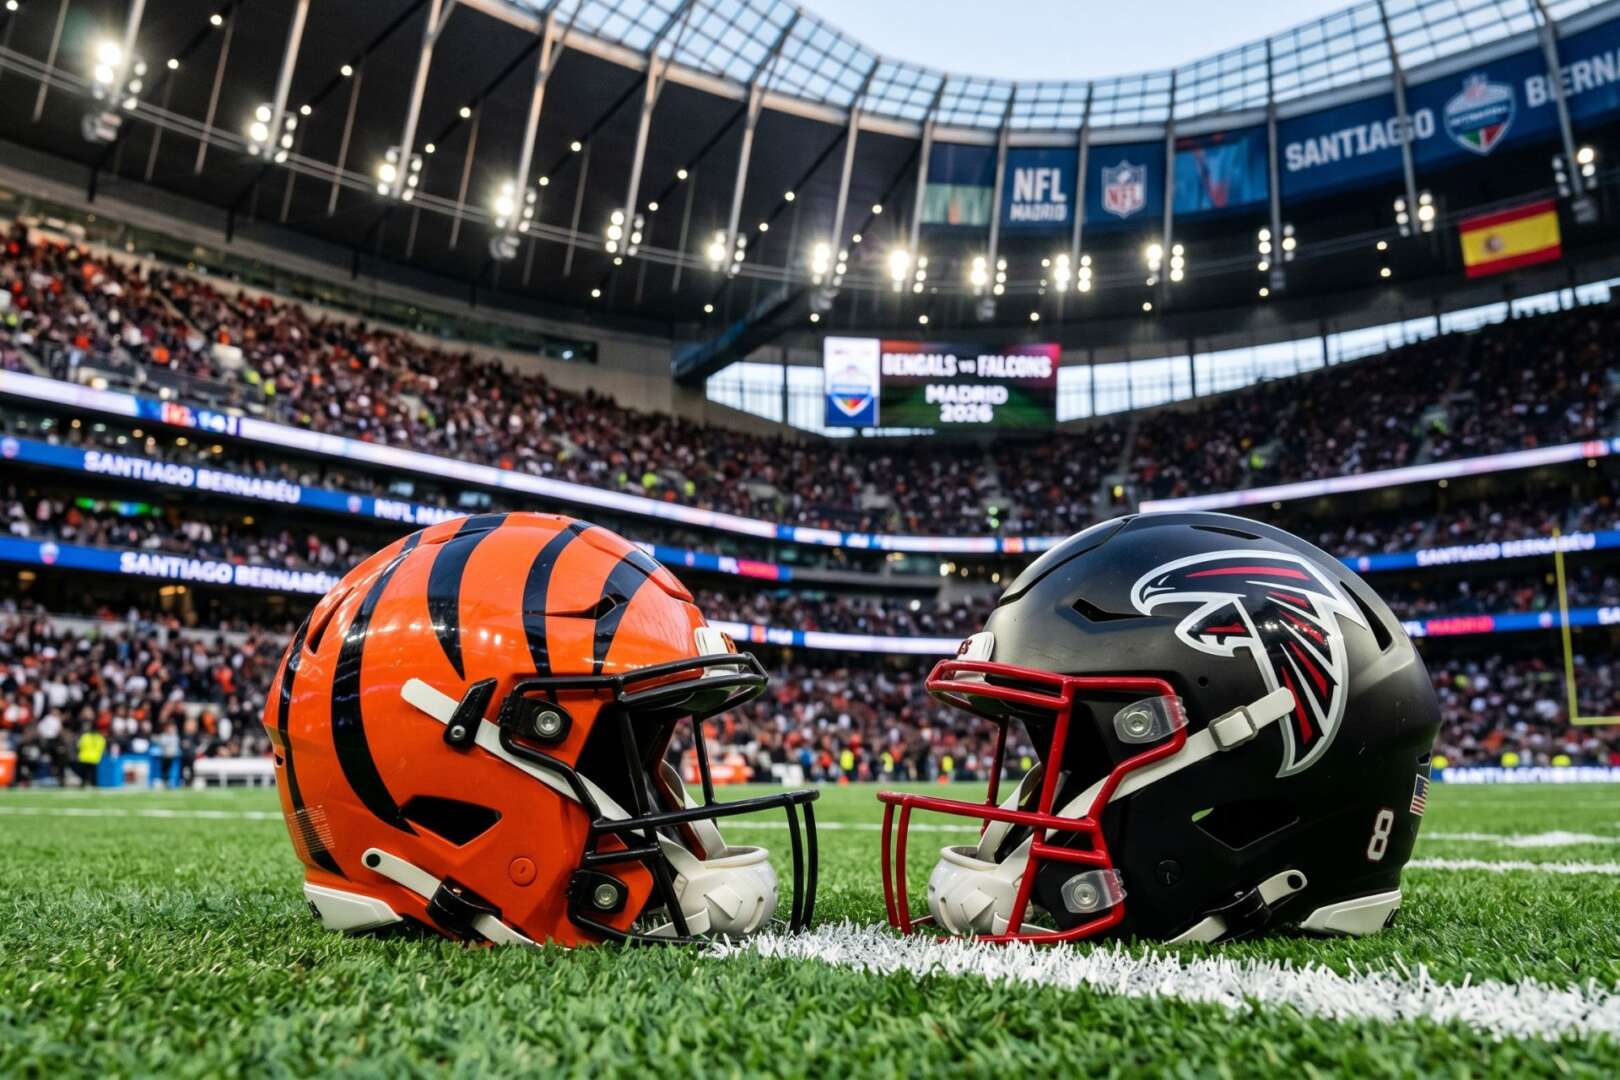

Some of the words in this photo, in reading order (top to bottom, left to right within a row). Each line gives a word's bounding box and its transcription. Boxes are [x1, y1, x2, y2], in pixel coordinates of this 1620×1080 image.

[1525, 48, 1620, 108] BERN
[1013, 167, 1067, 202] NFL
[1009, 203, 1067, 221] MADRID
[882, 353, 957, 376] BENGALS
[977, 355, 1052, 377] FALCONS
[925, 384, 1008, 404] MADRID
[940, 404, 993, 422] 2026
[84, 451, 194, 486] SANTIAGO
[196, 468, 301, 503] BERNABÉU
[374, 498, 415, 523] NFL
[120, 552, 234, 584] SANTIAGO
[1367, 808, 1394, 862] 8
